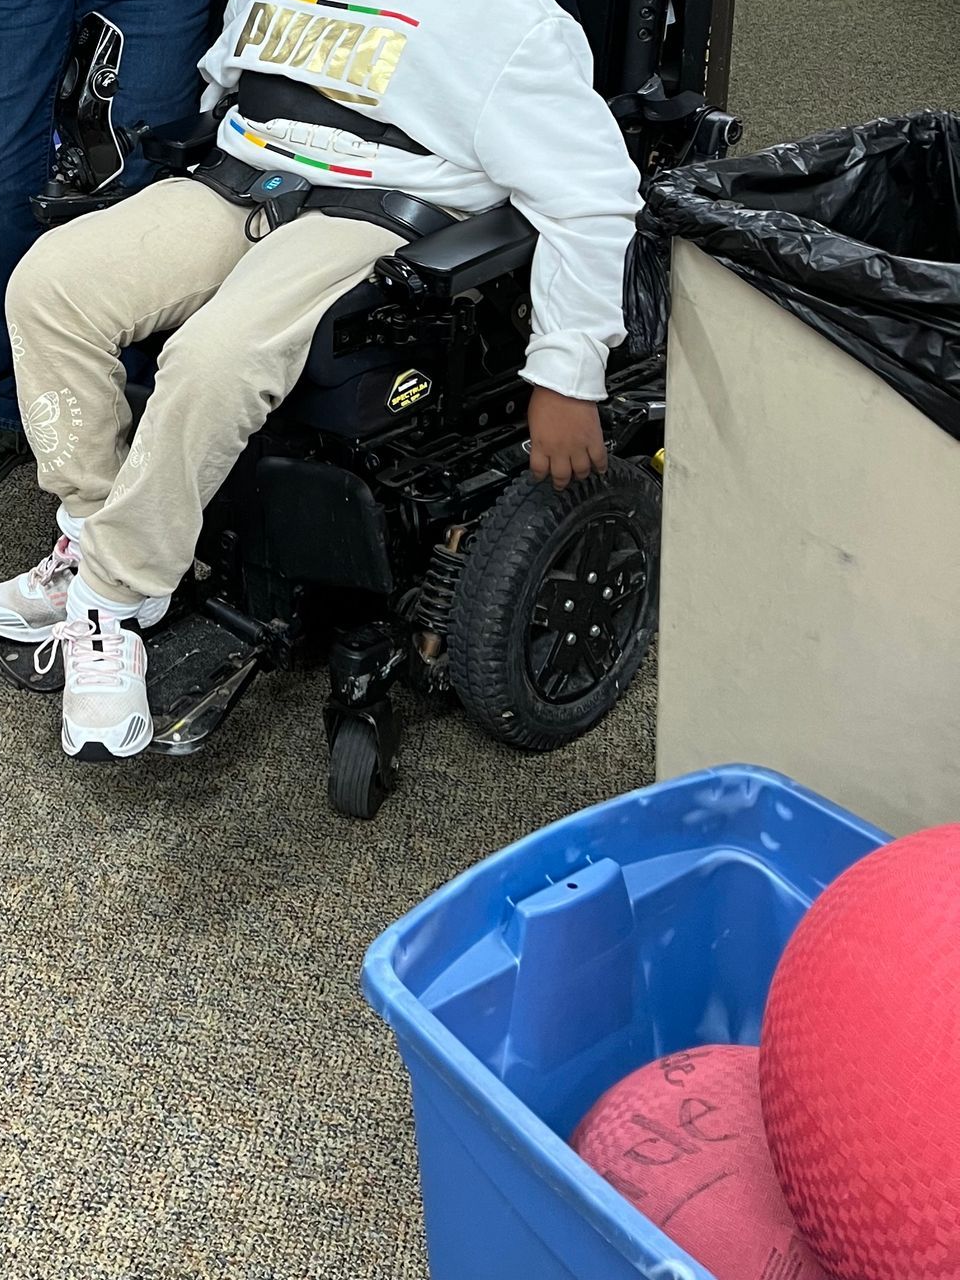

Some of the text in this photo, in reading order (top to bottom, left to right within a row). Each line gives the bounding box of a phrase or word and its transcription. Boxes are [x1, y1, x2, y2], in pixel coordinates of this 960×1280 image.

[233, 1, 408, 96] PUMA
[41, 387, 83, 473] FREE SPIRIT
